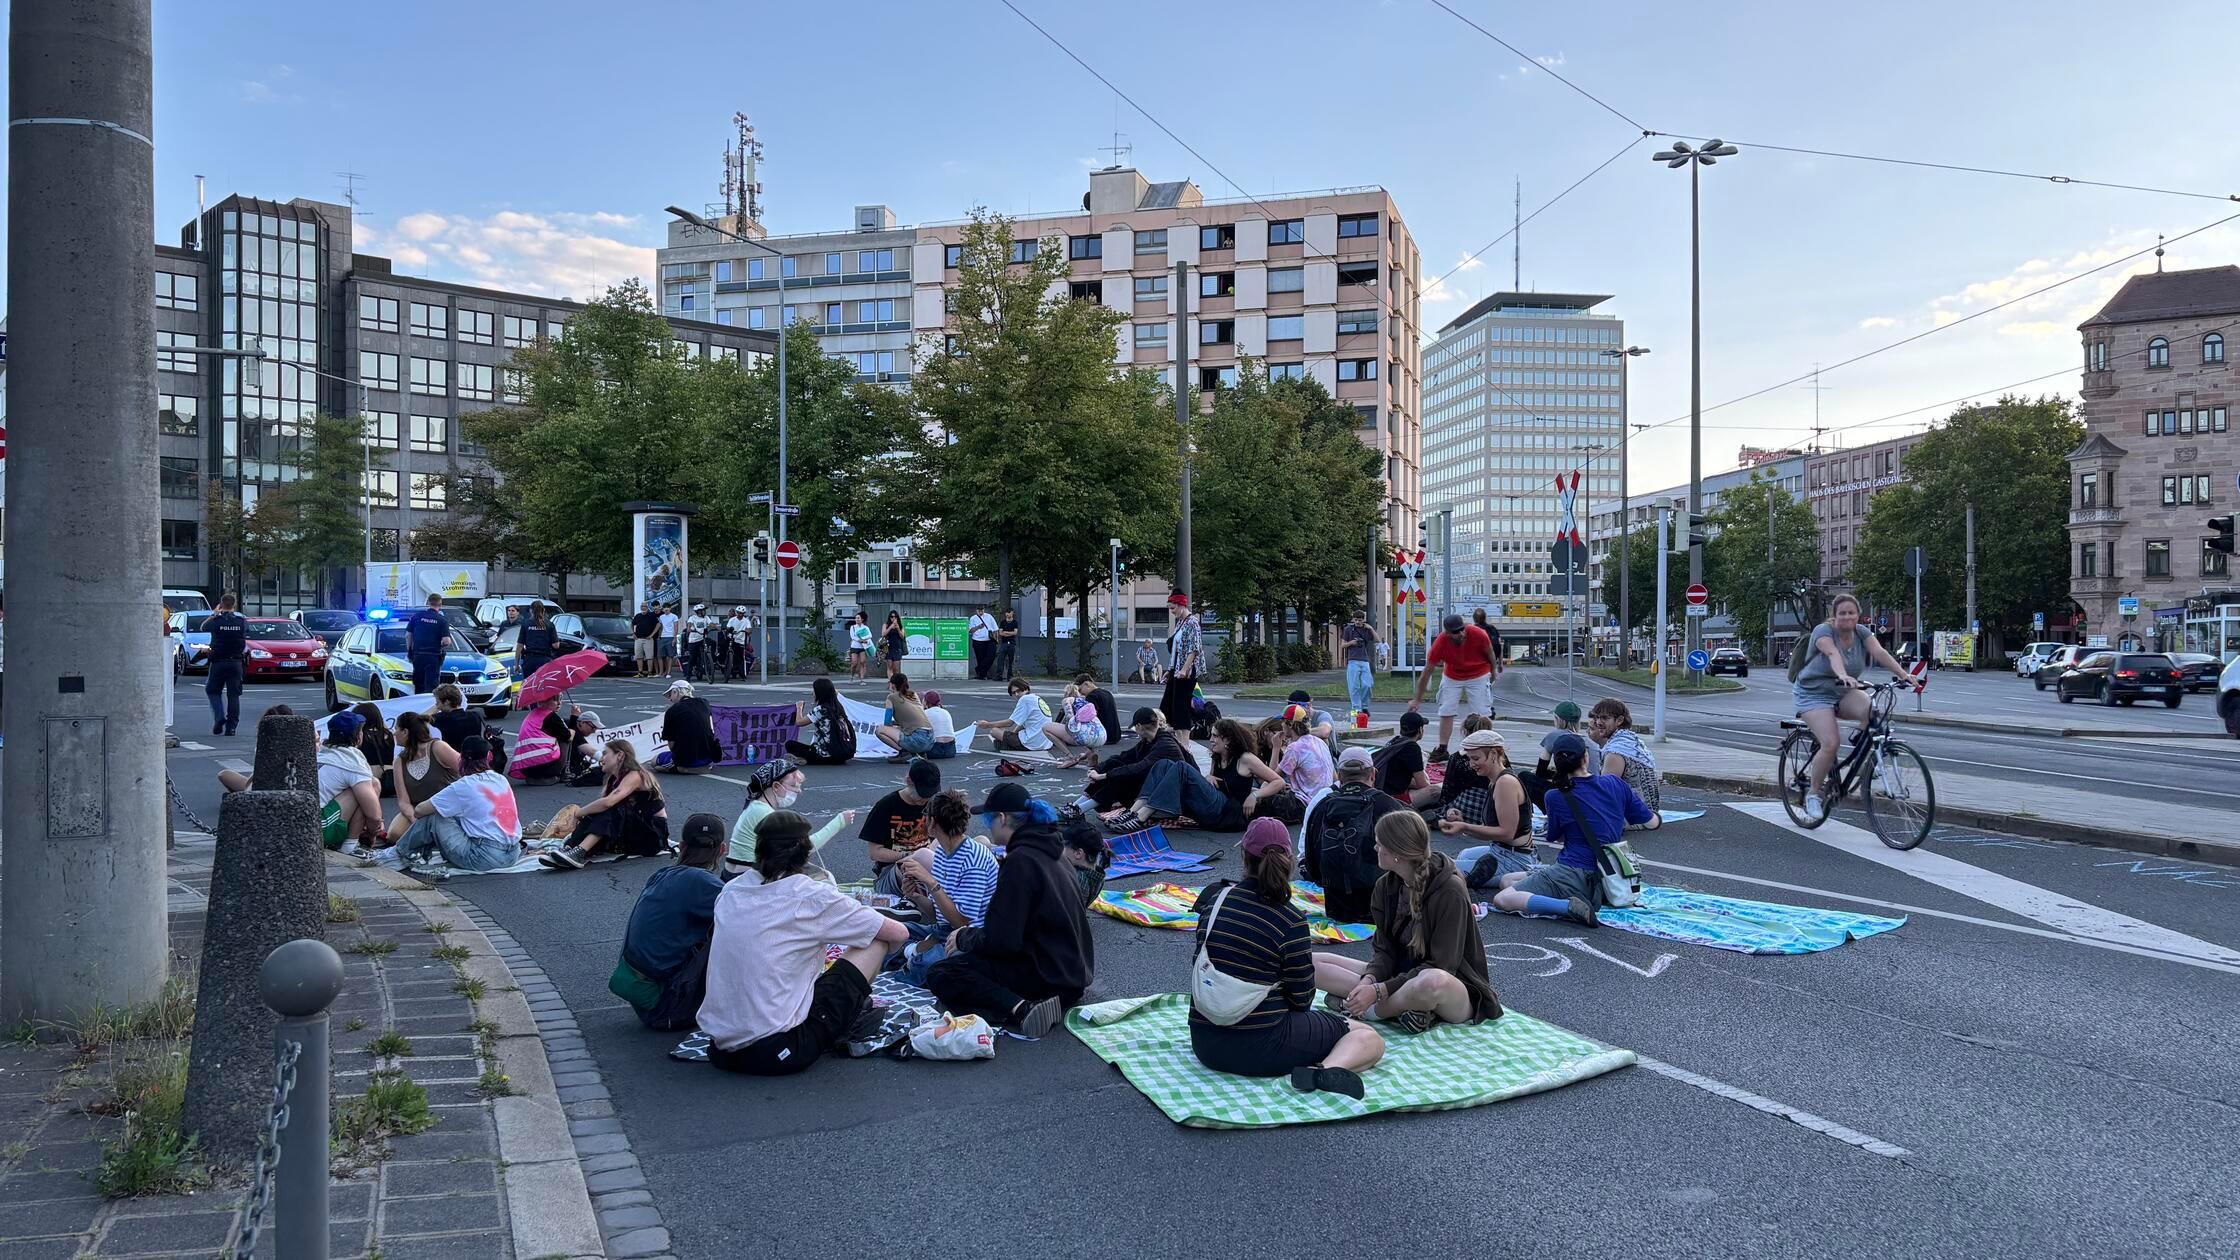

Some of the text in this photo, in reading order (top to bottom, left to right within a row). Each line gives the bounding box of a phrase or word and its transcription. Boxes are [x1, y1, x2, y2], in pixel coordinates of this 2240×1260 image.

[1824, 485, 1835, 496] DES
[1835, 480, 1872, 494] BAYERISCHEN
[1873, 474, 1908, 487] GASTGEW
